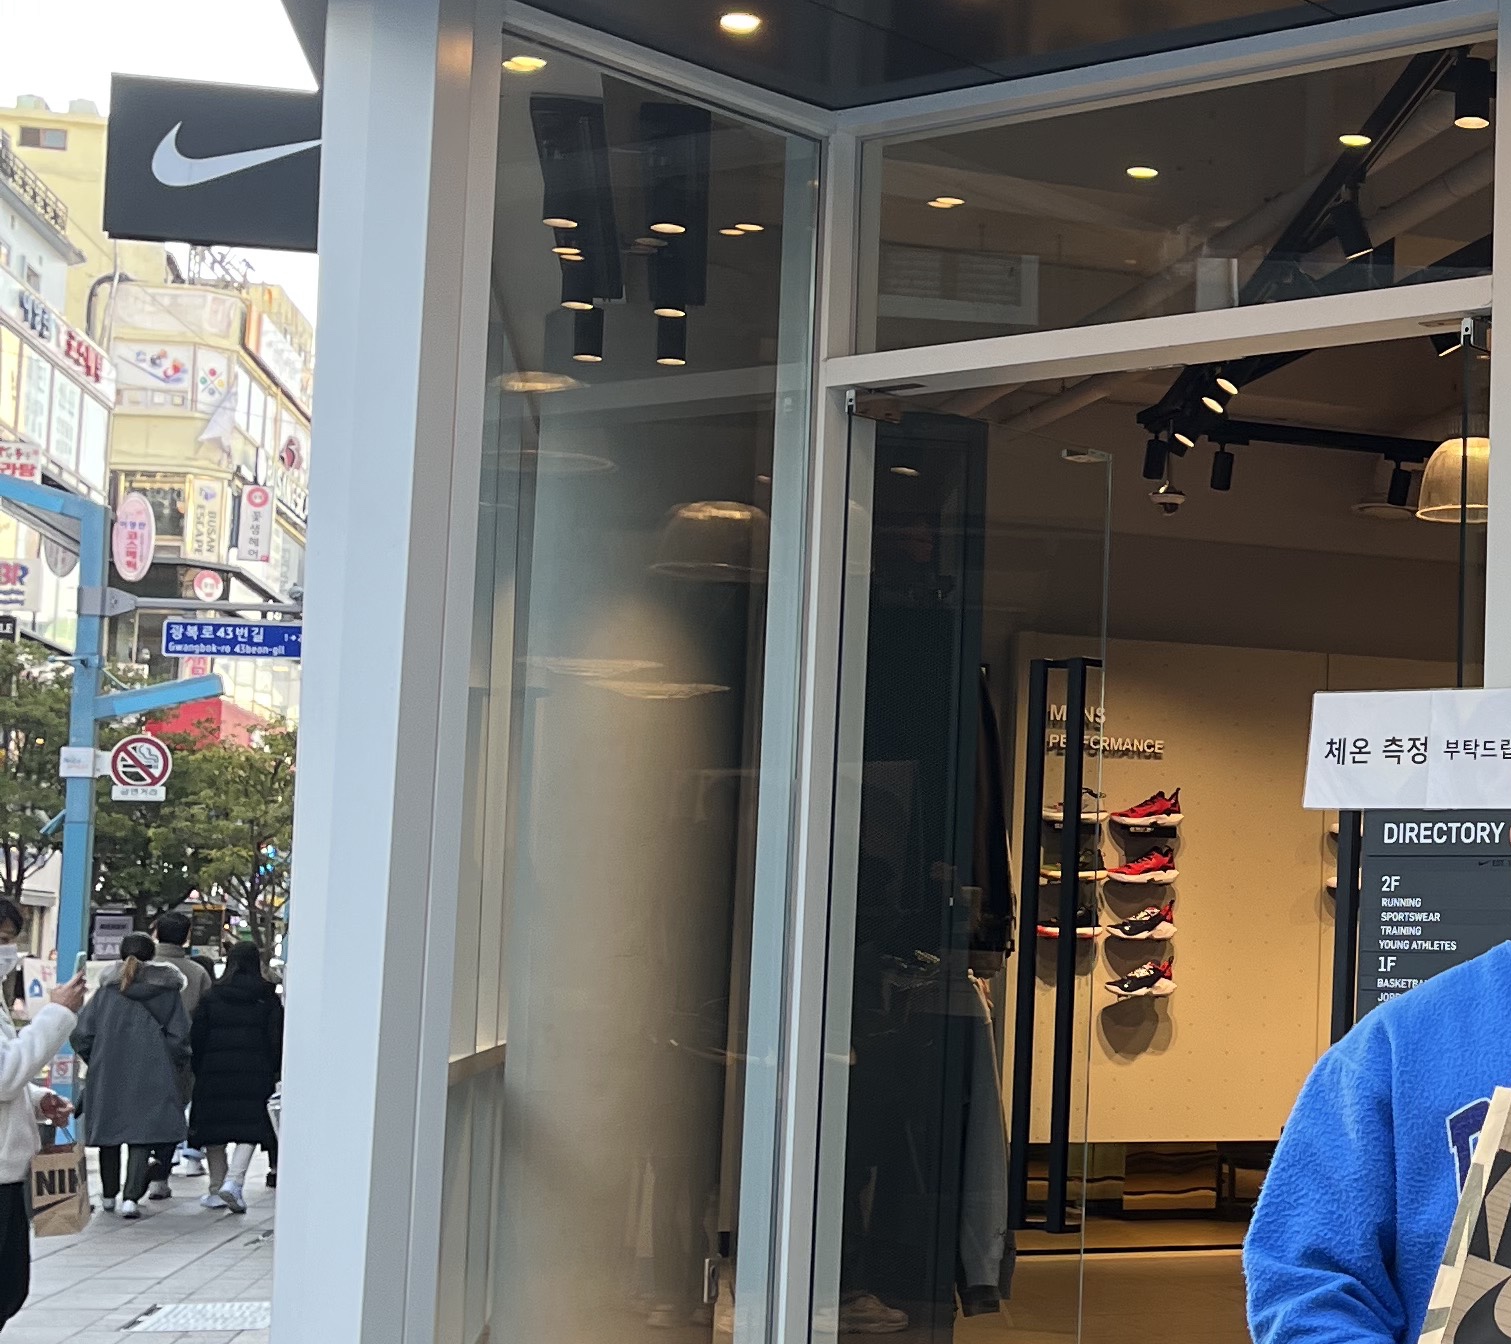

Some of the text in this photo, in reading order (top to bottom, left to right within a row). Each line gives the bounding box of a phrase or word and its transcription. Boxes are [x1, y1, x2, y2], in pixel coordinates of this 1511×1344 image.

[206, 511, 217, 554] BUSAN
[1049, 704, 1106, 723] MNS
[1324, 737, 1371, 765] 체온
[1382, 736, 1429, 765] 측정
[1383, 822, 1505, 844] DIRECTORY
[1381, 876, 1401, 892] 2F
[1381, 898, 1422, 907] RUNNING
[1381, 912, 1441, 922] SPORTSWEAR
[1381, 926, 1422, 936] TRAINING
[1379, 940, 1457, 951] YOUNG ATHLETES
[1378, 957, 1397, 972] 1F
